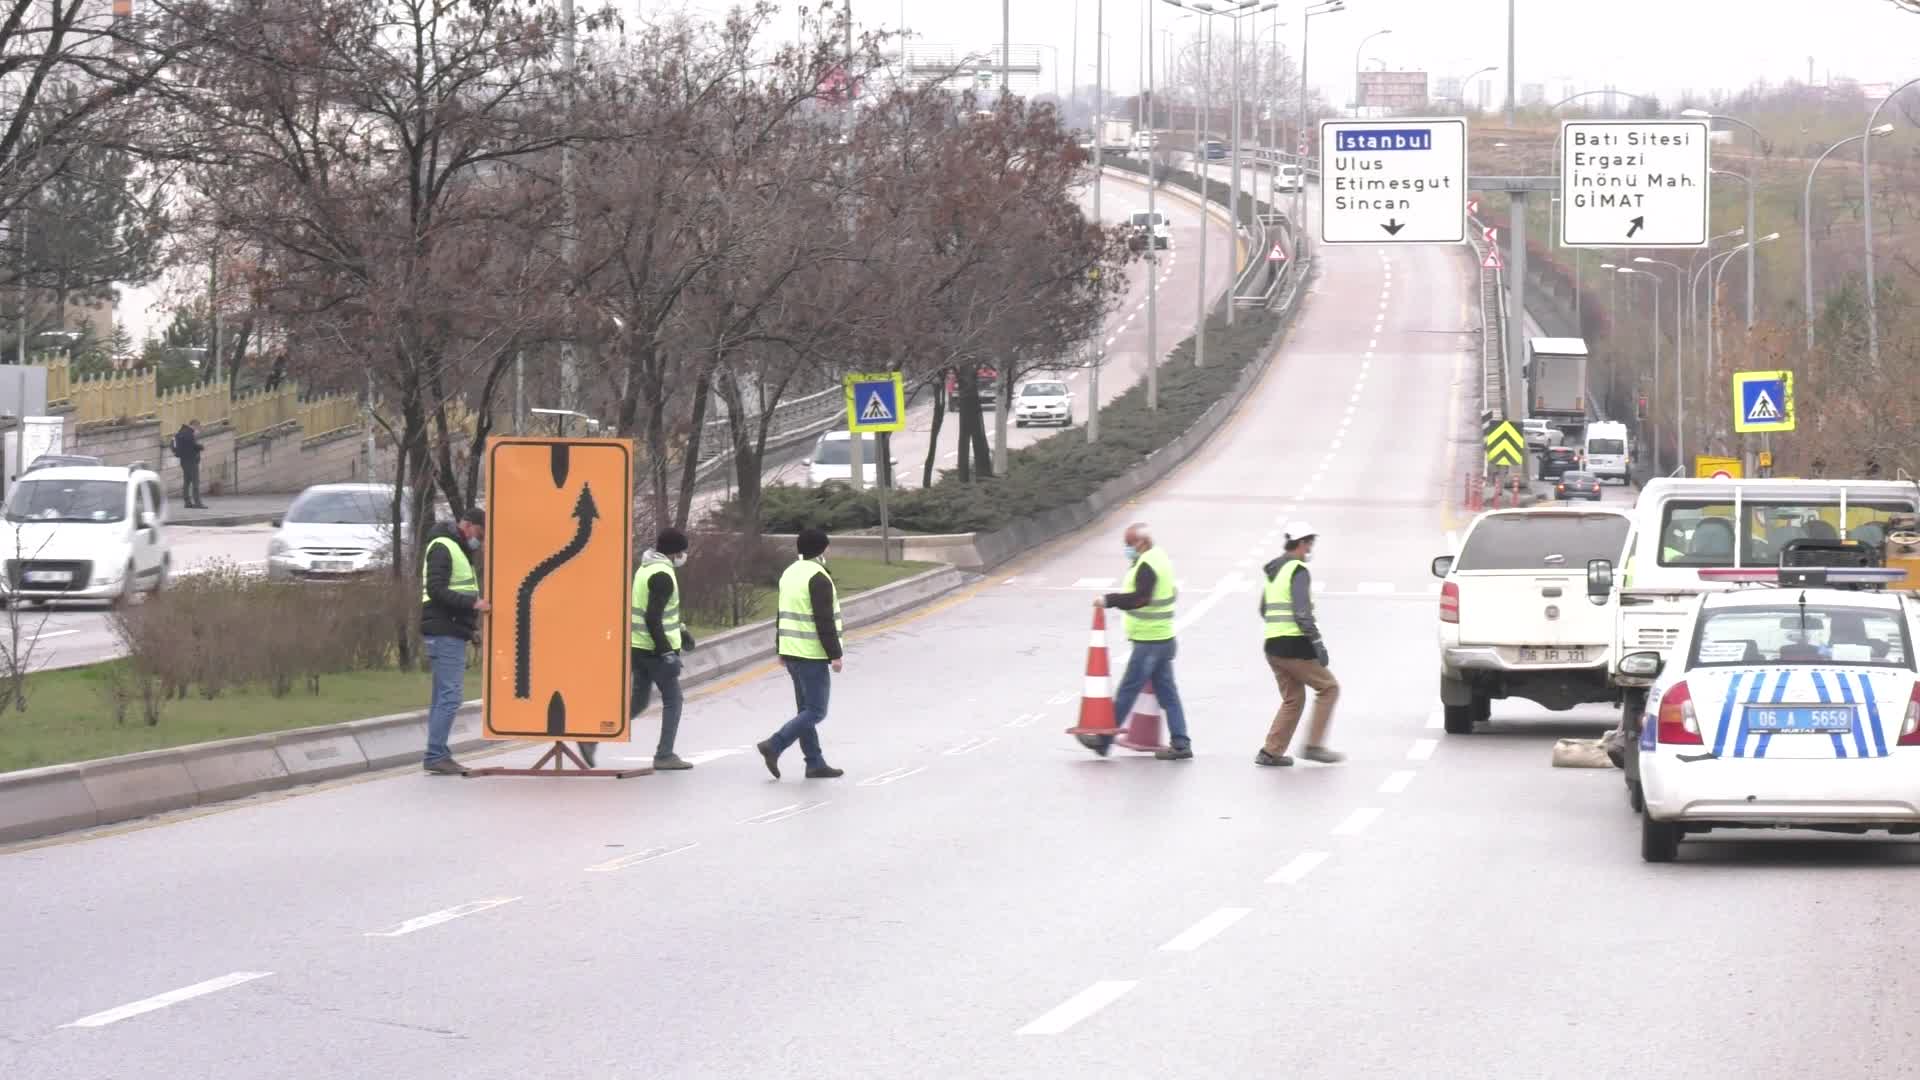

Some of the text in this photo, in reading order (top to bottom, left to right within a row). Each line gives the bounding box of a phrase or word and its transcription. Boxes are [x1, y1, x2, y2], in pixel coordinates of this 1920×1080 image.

[1338, 132, 1429, 149] İstanbul
[1575, 131, 1689, 146] Batı Sitesi
[1335, 156, 1383, 171] Ulus
[1575, 151, 1644, 169] Ergazi
[1335, 176, 1451, 192] Etimesgut
[1573, 169, 1696, 188] İnönü Mah.
[1335, 196, 1410, 210] Sincan
[1574, 190, 1644, 208] GİMAT
[1759, 711, 1848, 726] 06 A 5659
